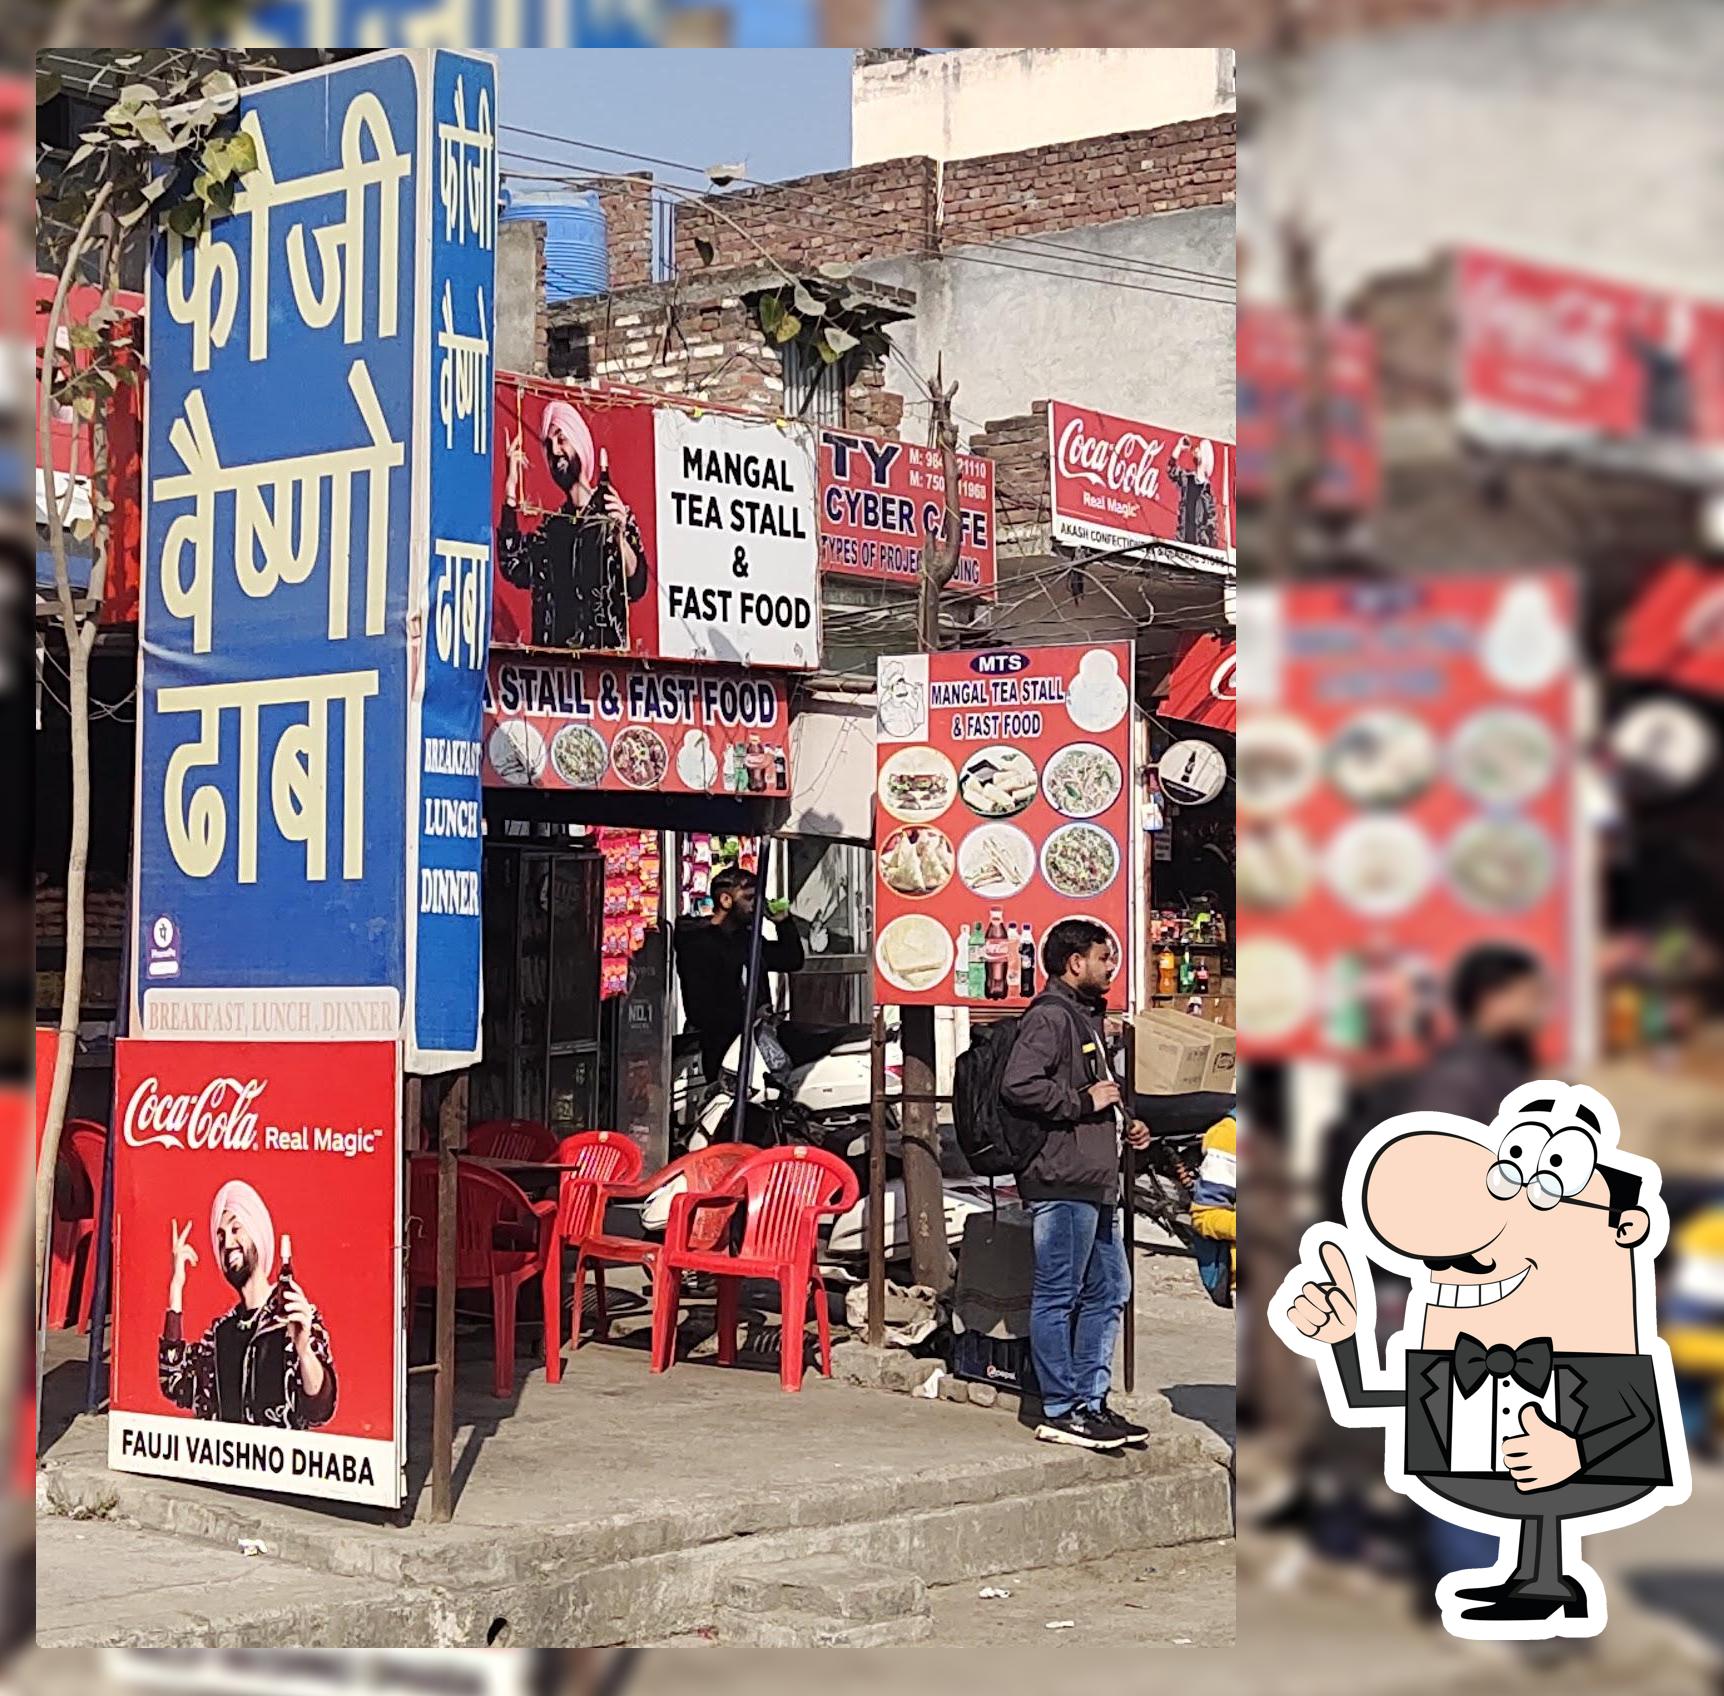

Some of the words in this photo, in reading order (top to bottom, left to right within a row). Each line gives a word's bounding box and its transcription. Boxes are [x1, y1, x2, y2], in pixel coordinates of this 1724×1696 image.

[683, 446, 794, 492] MANGAL
[823, 432, 899, 484] TY
[671, 491, 723, 529] TEA
[730, 499, 806, 539] STALL
[826, 487, 915, 534] CYBER
[923, 504, 987, 546] CFE
[1061, 522, 1089, 539] AKASH
[733, 545, 748, 578] &
[862, 542, 875, 567] OF
[435, 539, 489, 670] ढाबा
[669, 585, 732, 622] FAST
[740, 592, 810, 629] FOOD
[979, 655, 1021, 672] MTS
[501, 665, 593, 716] STALL
[601, 671, 620, 716] &
[629, 674, 696, 722] FAST
[703, 679, 776, 724] FOOD
[931, 683, 987, 704] MANGAL
[992, 681, 1017, 702] TEA
[1023, 680, 1063, 701] STALL
[953, 716, 961, 737] &
[968, 715, 1000, 737] FAST
[1004, 714, 1040, 735] FOOD
[157, 670, 379, 883] ढाबा
[424, 738, 482, 776] BREAKFAST
[424, 798, 478, 838] LUNCH
[421, 869, 479, 916] DINNER
[322, 1001, 393, 1033] DINNER
[124, 1077, 268, 1150] Coca-Cola
[265, 1127, 308, 1150] Real
[122, 1429, 179, 1461] FAUJI
[186, 1436, 284, 1473] VAISHNO
[292, 1448, 374, 1486] DHABA
